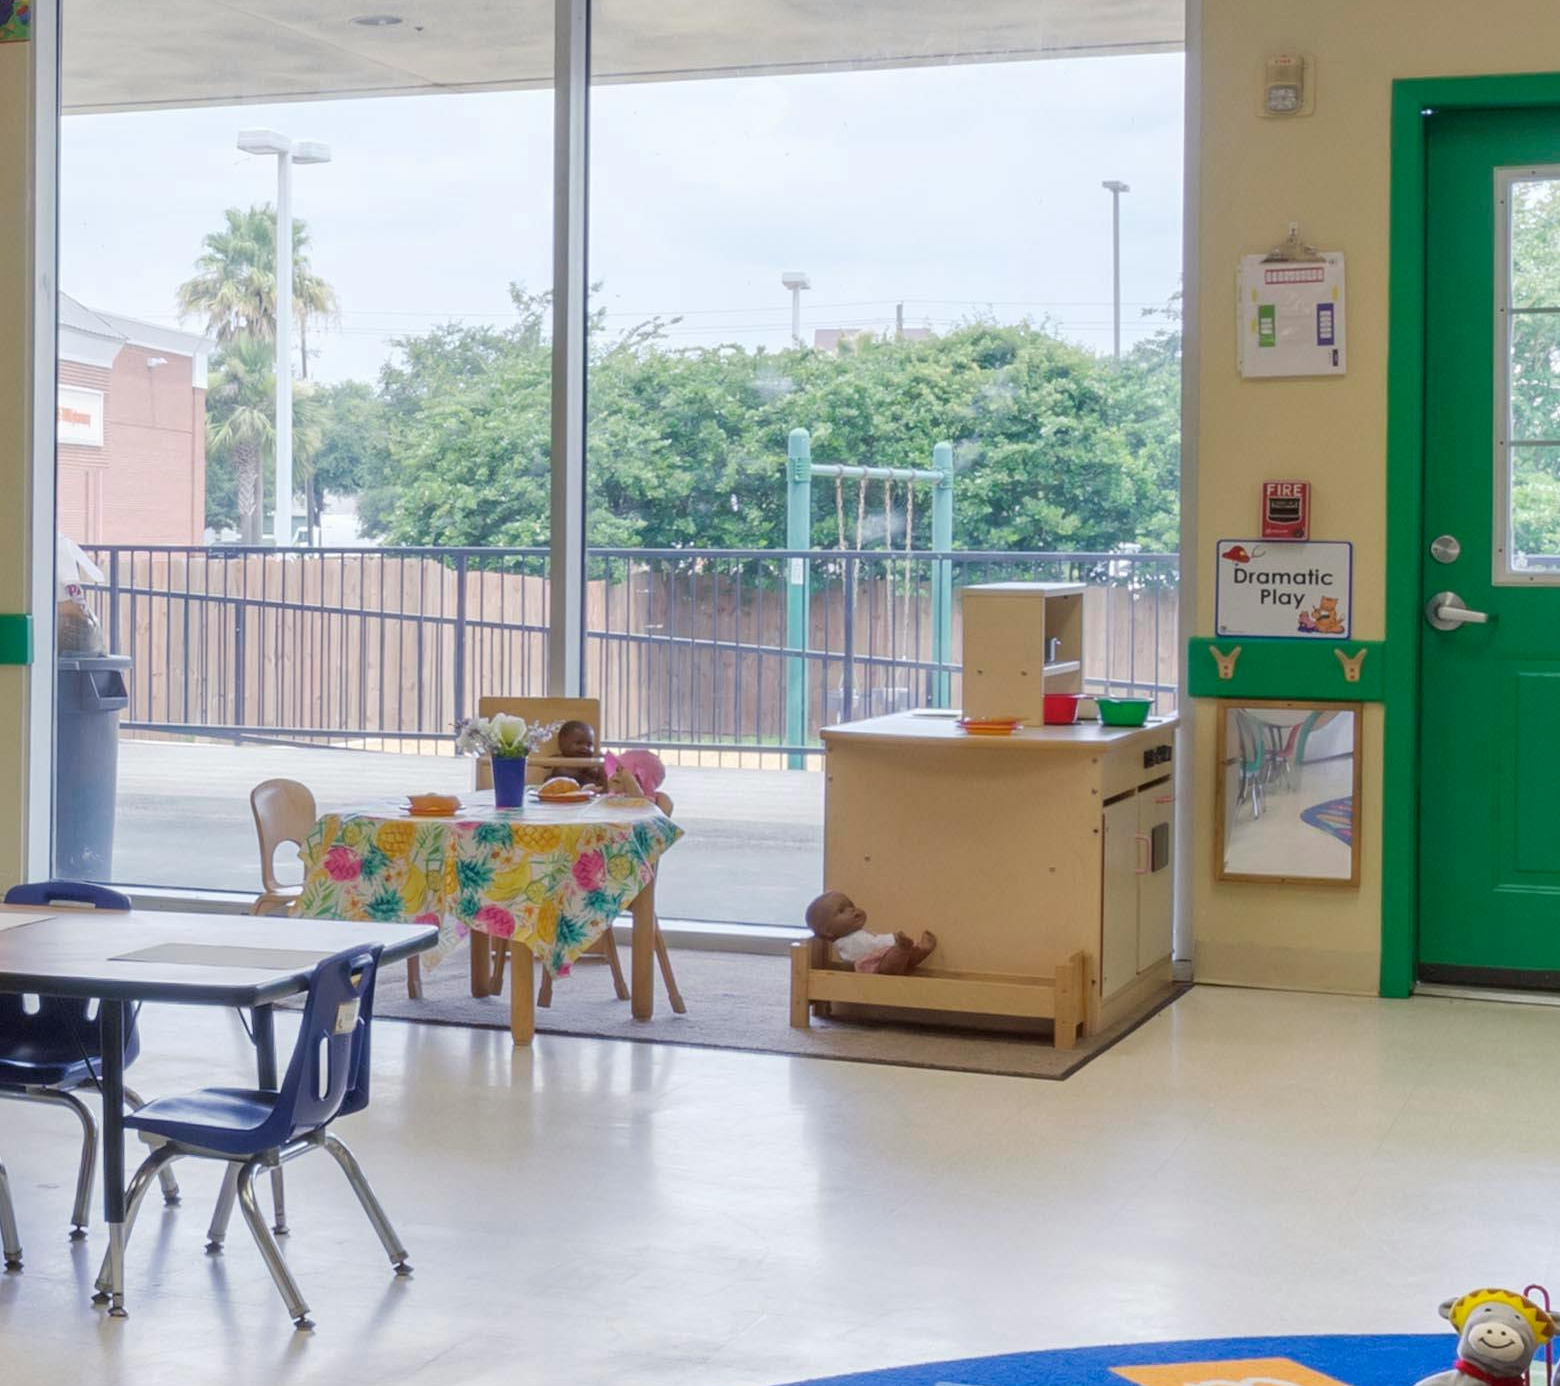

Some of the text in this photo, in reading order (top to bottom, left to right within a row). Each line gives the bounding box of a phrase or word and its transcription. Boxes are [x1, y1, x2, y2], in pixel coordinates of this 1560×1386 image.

[1266, 484, 1303, 496] FIRE
[1234, 568, 1333, 585] Dramatic
[1260, 589, 1305, 609] Play
